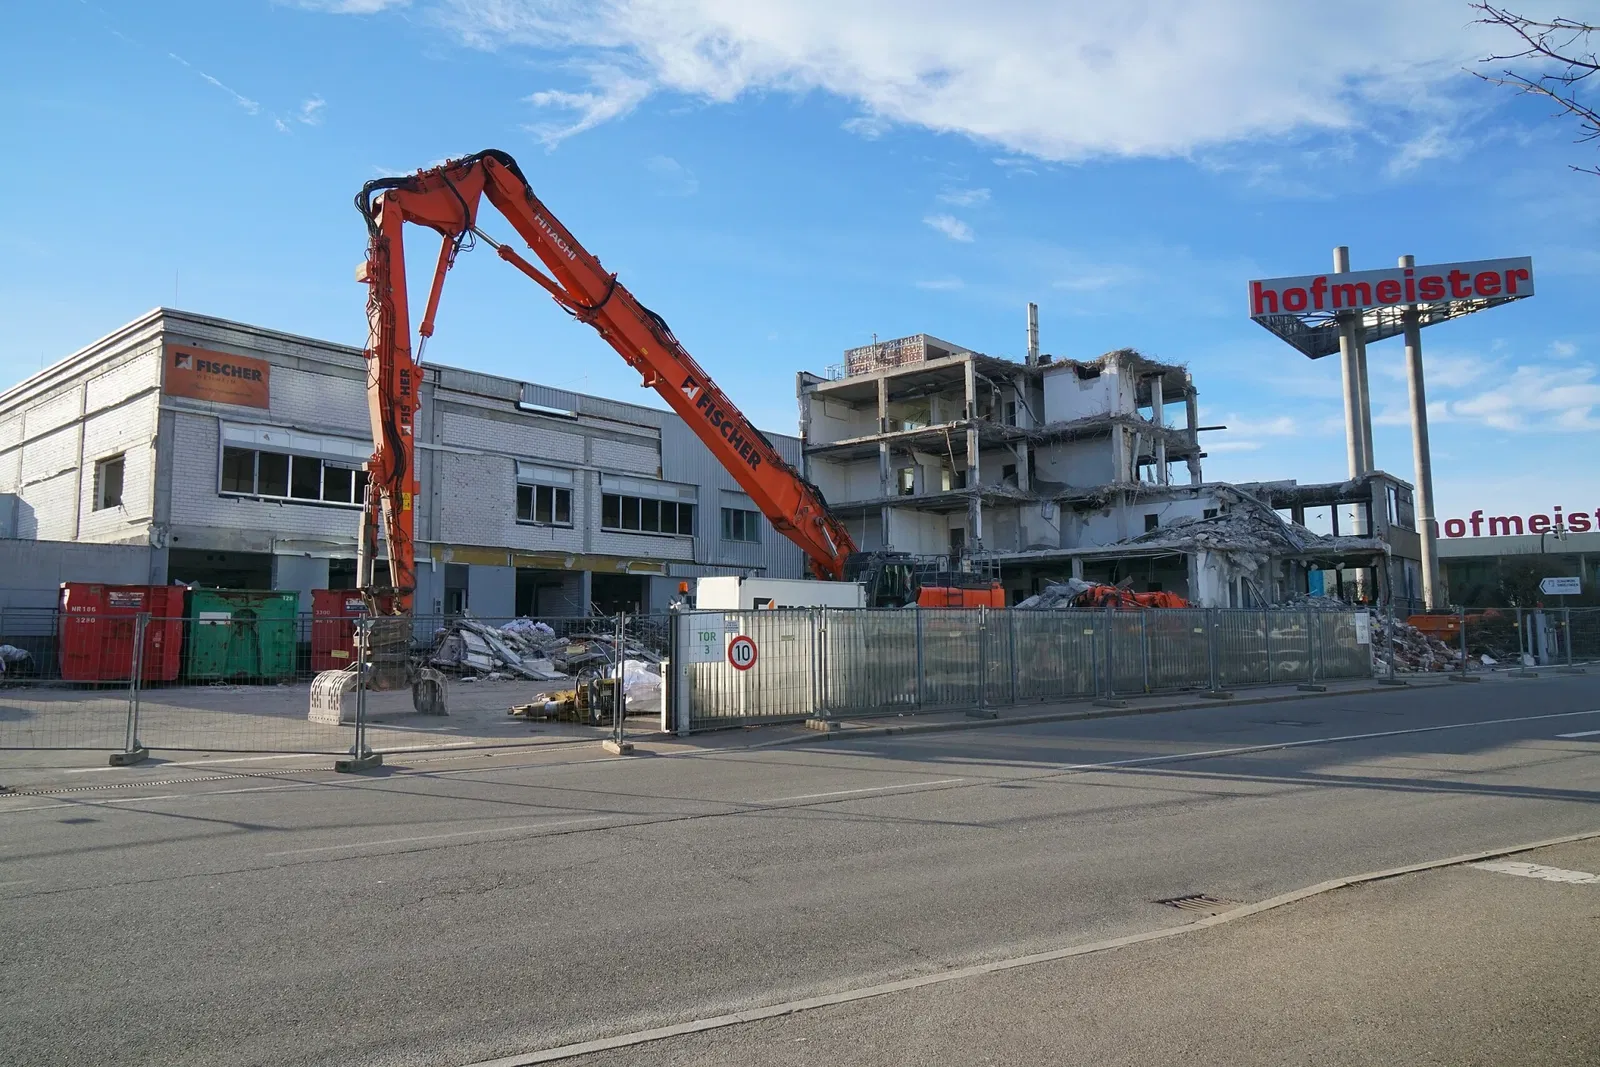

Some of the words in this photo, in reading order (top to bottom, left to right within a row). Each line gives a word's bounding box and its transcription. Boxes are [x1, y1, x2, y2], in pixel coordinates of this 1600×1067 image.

[534, 213, 577, 261] HITACHI
[1253, 268, 1529, 315] hofmeister
[196, 359, 262, 382] FISCHER
[400, 368, 411, 424] FISHER
[696, 392, 762, 471] FISCHER
[698, 631, 717, 642] TOR
[704, 644, 710, 655] 3
[735, 644, 751, 662] 10
